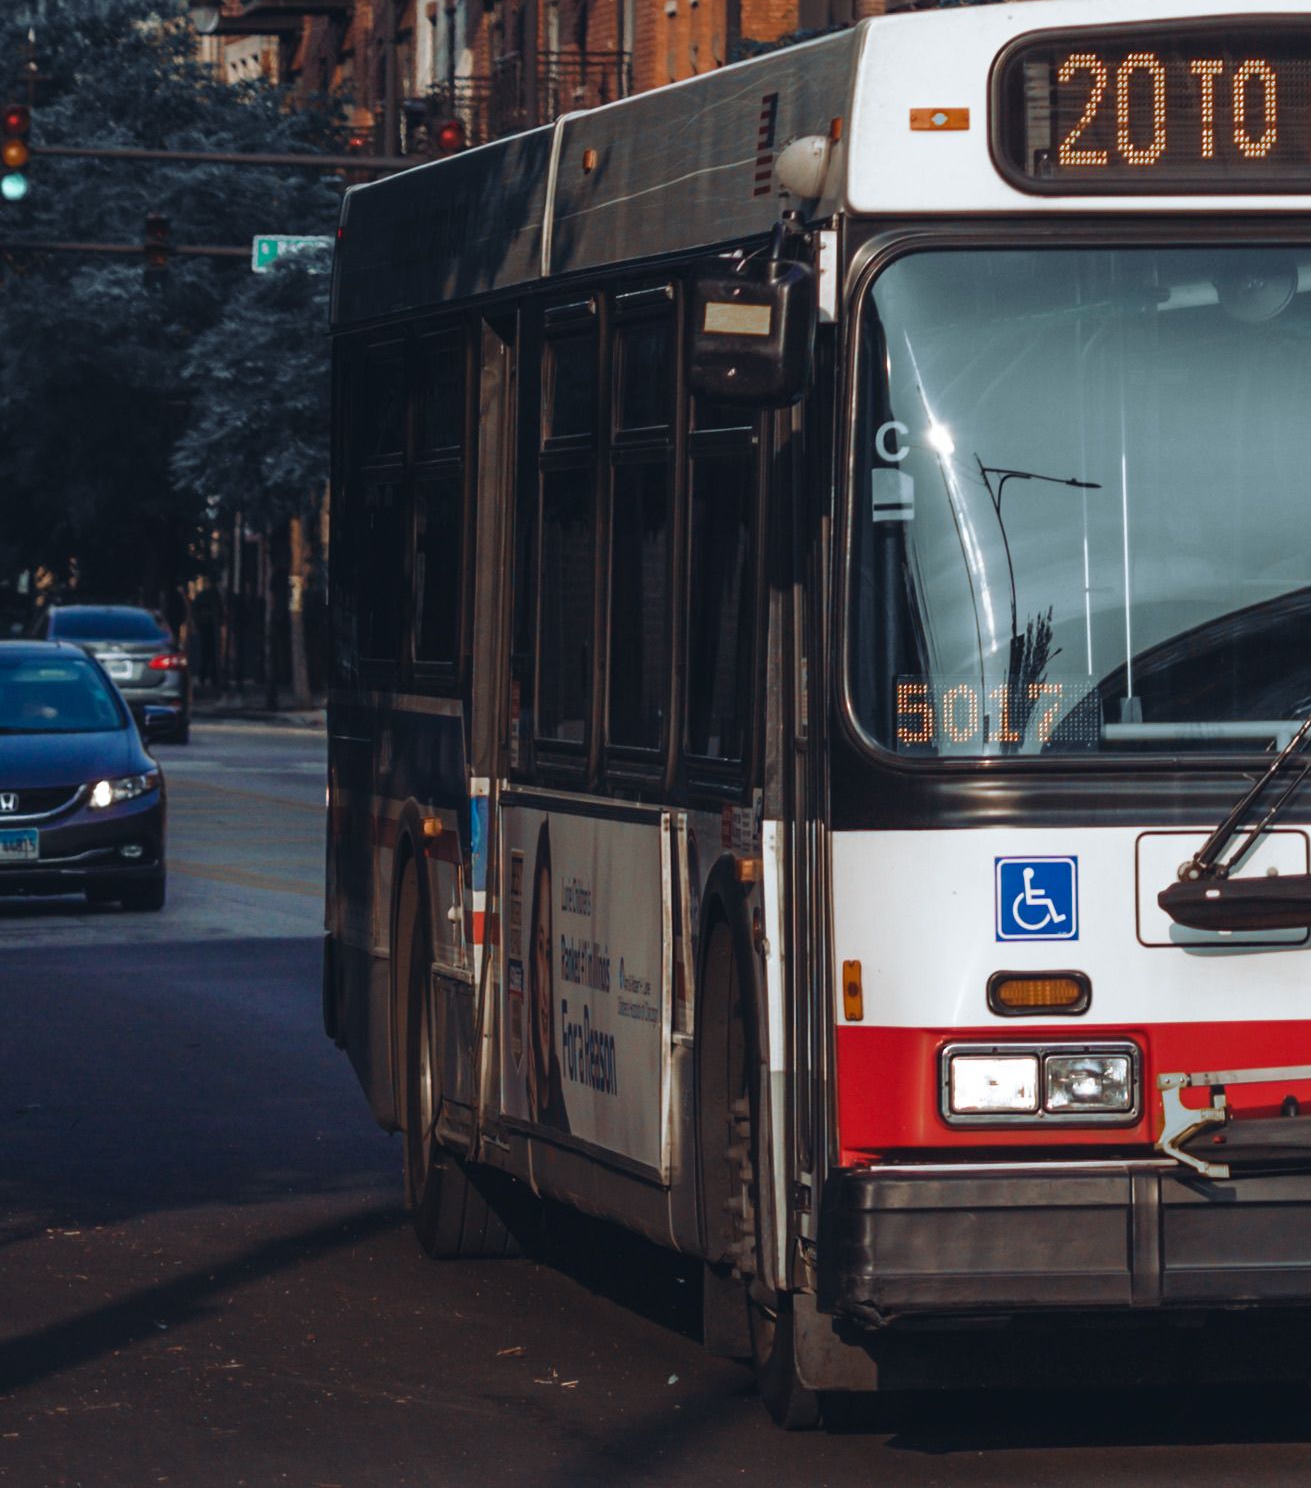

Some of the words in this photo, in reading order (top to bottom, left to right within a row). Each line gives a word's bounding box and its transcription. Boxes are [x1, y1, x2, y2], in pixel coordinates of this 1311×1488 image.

[1058, 53, 1166, 166] 20
[1190, 60, 1277, 159] TO
[875, 420, 911, 462] C
[896, 683, 1063, 742] 5017
